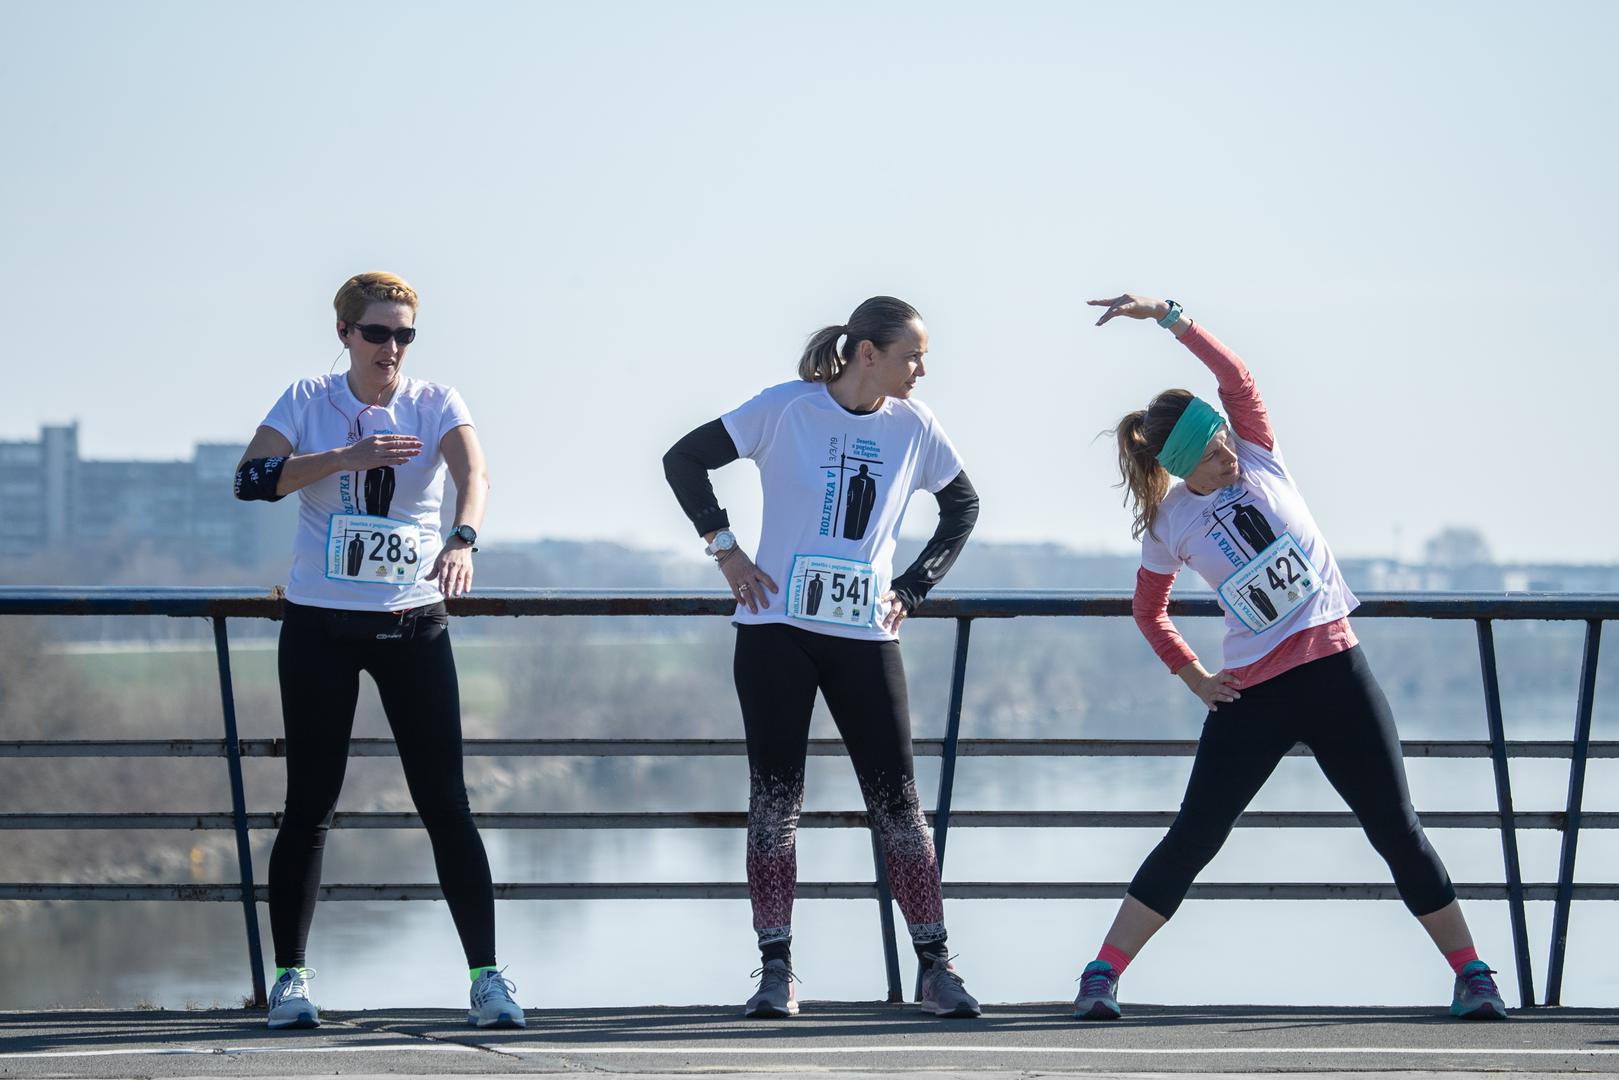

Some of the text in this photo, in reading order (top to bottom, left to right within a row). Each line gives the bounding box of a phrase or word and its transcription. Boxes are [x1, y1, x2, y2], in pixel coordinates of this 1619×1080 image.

[829, 437, 839, 461] 3/3/19
[820, 471, 837, 536] HOLJEVKA V
[369, 532, 417, 564] 283
[1266, 547, 1309, 590] 421
[831, 573, 869, 606] 541
